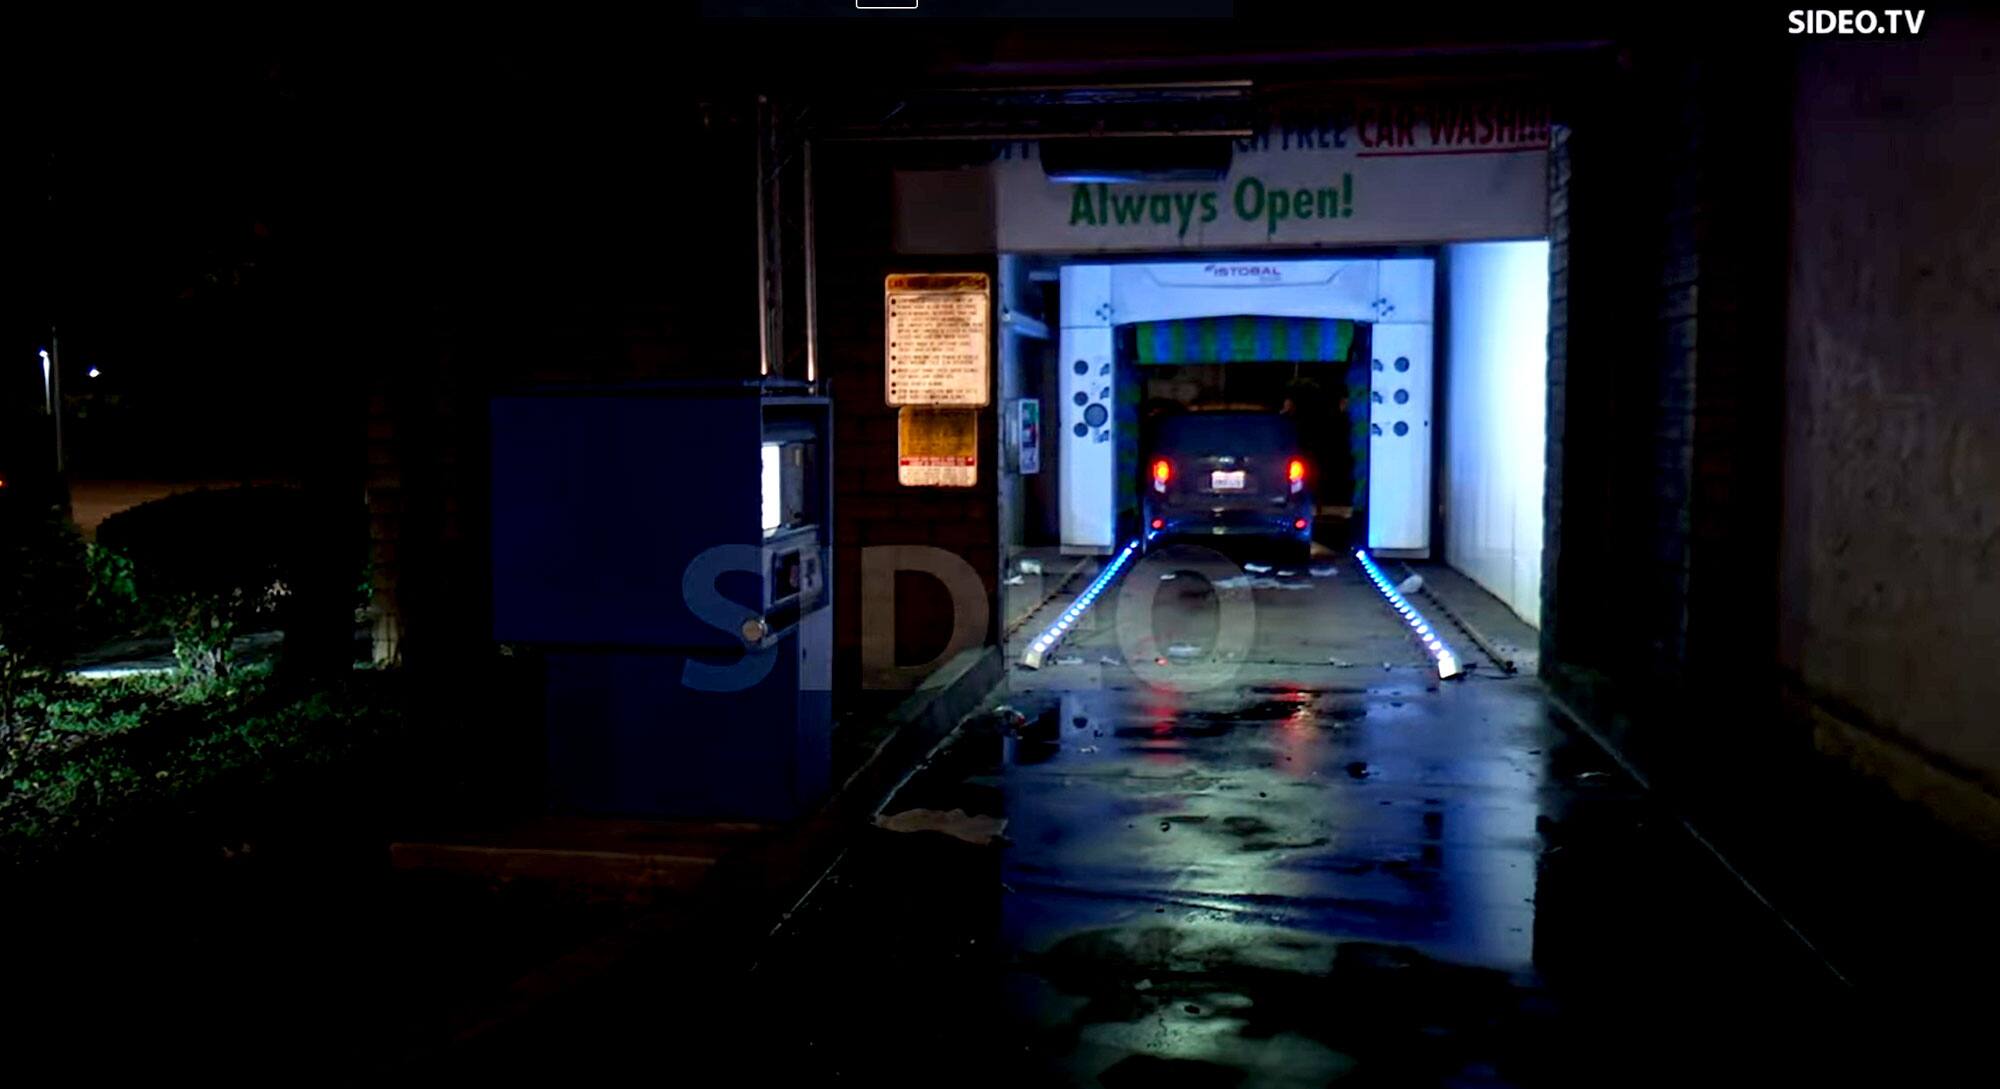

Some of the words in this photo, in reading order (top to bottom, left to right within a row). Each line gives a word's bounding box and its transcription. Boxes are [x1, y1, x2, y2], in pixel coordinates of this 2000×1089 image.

[1282, 108, 1346, 149] FREE
[1357, 104, 1414, 147] CAR
[1070, 182, 1218, 237] Always
[1235, 174, 1353, 234] Open!
[1213, 266, 1281, 277] ISTOBAL
